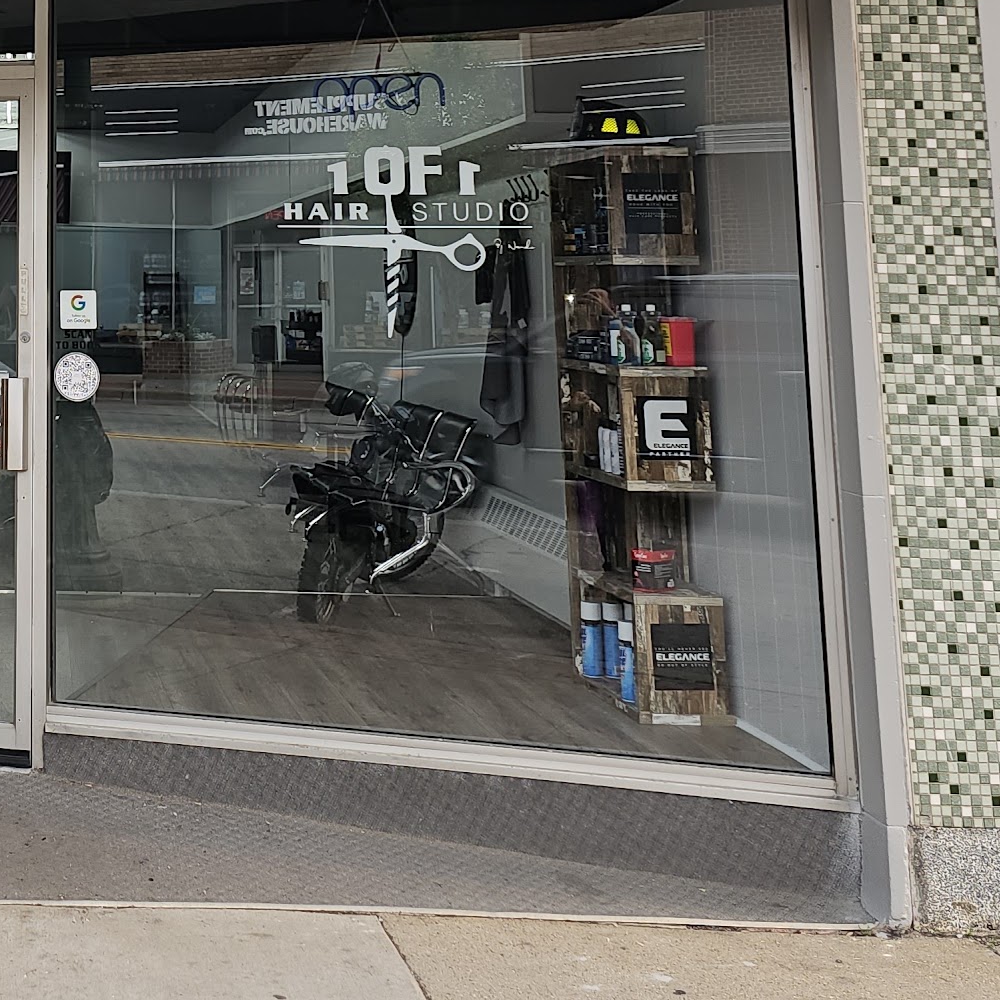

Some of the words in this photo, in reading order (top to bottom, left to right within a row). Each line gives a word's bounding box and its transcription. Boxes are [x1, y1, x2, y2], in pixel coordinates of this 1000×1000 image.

[327, 160, 349, 195] 1
[363, 145, 443, 196] OF
[458, 160, 481, 196] 1
[283, 202, 369, 221] HAIR
[411, 201, 530, 222] STUDIO
[655, 653, 710, 661] ELEGANCE
